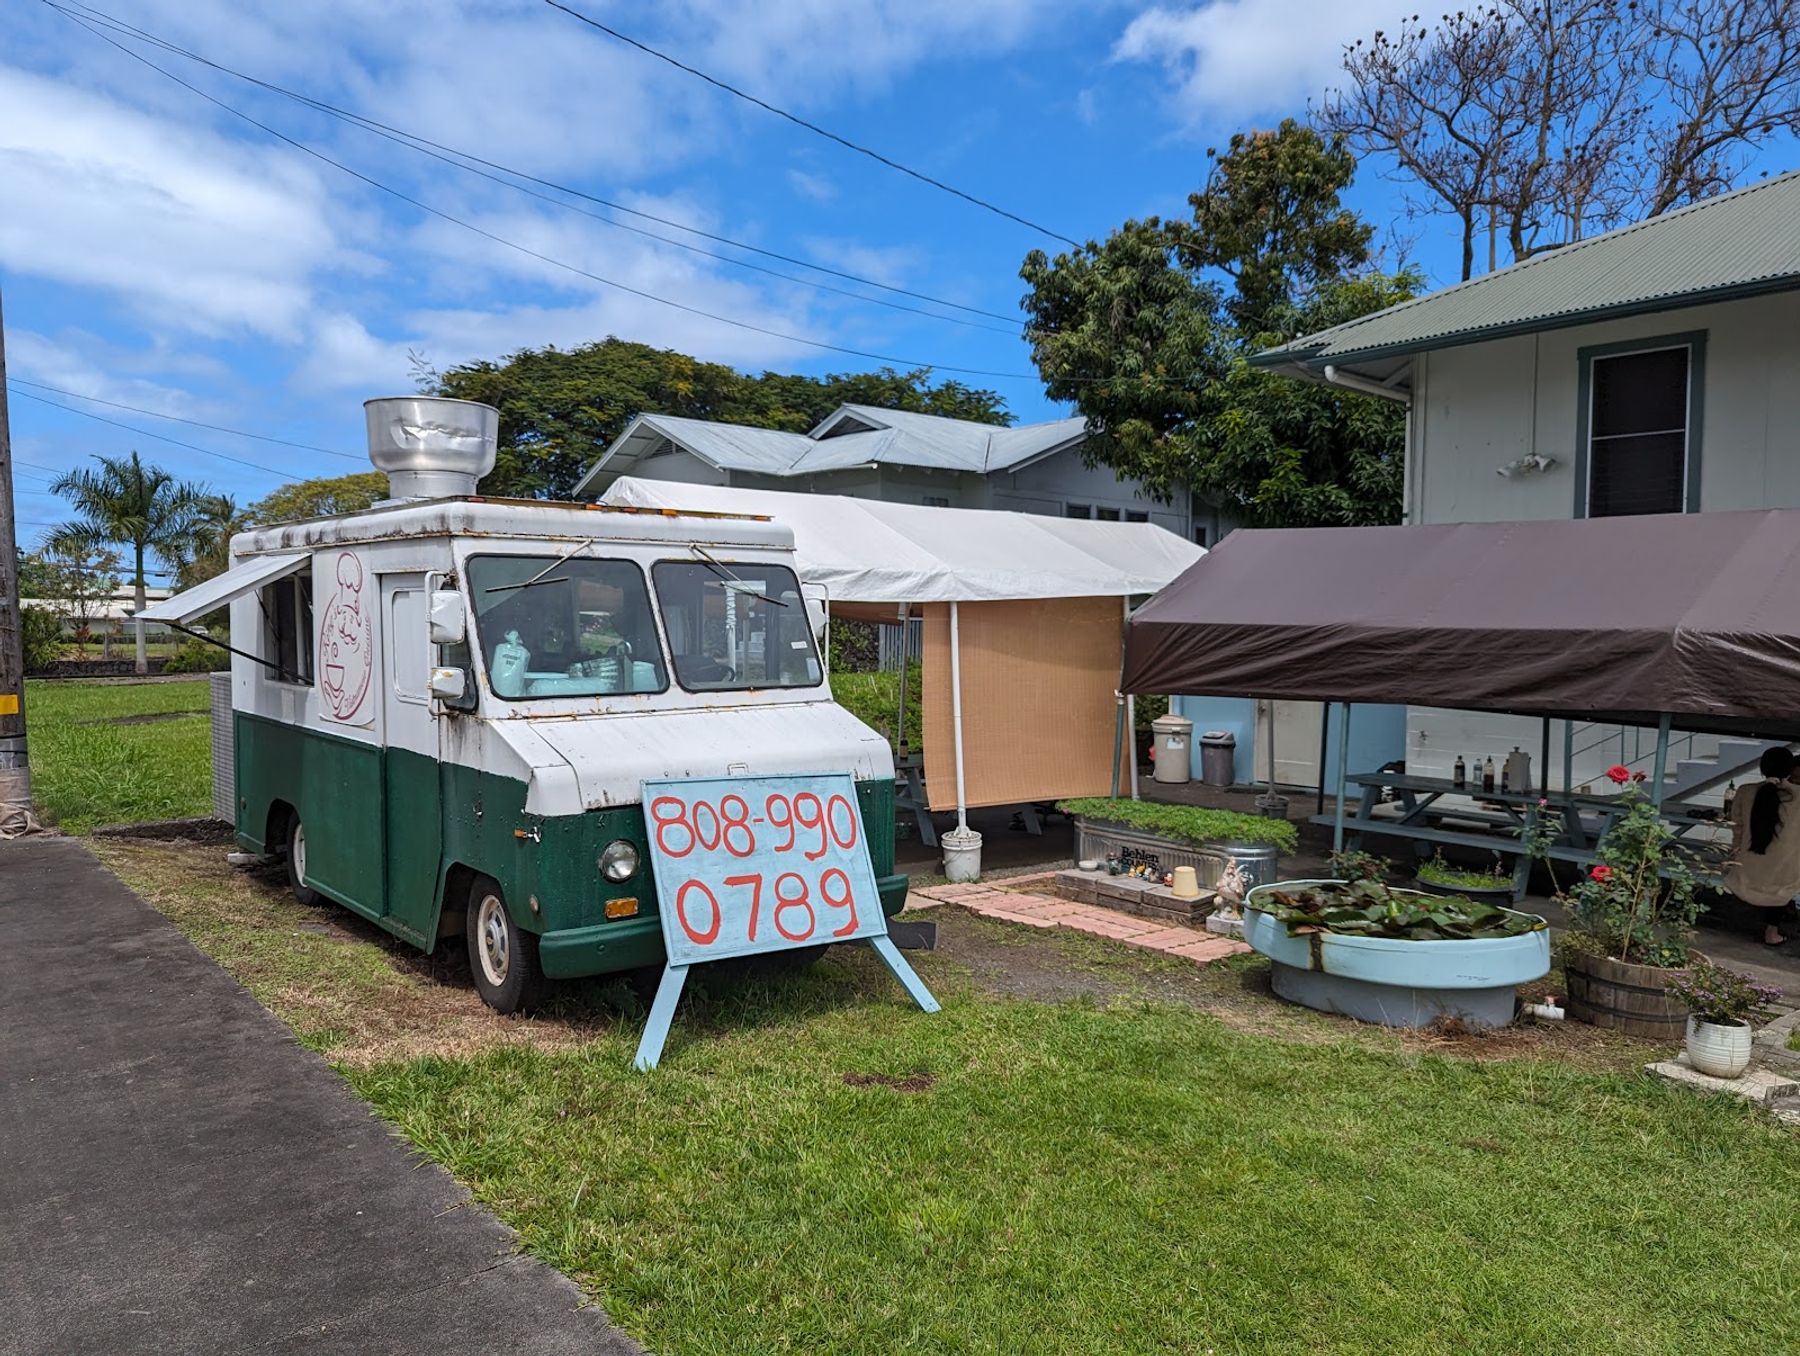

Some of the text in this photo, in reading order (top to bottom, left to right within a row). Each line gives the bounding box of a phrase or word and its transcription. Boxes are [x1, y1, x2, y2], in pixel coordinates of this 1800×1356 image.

[651, 792, 857, 861] 808-990
[1121, 846, 1159, 863] Behlen
[676, 867, 859, 945] 0789
